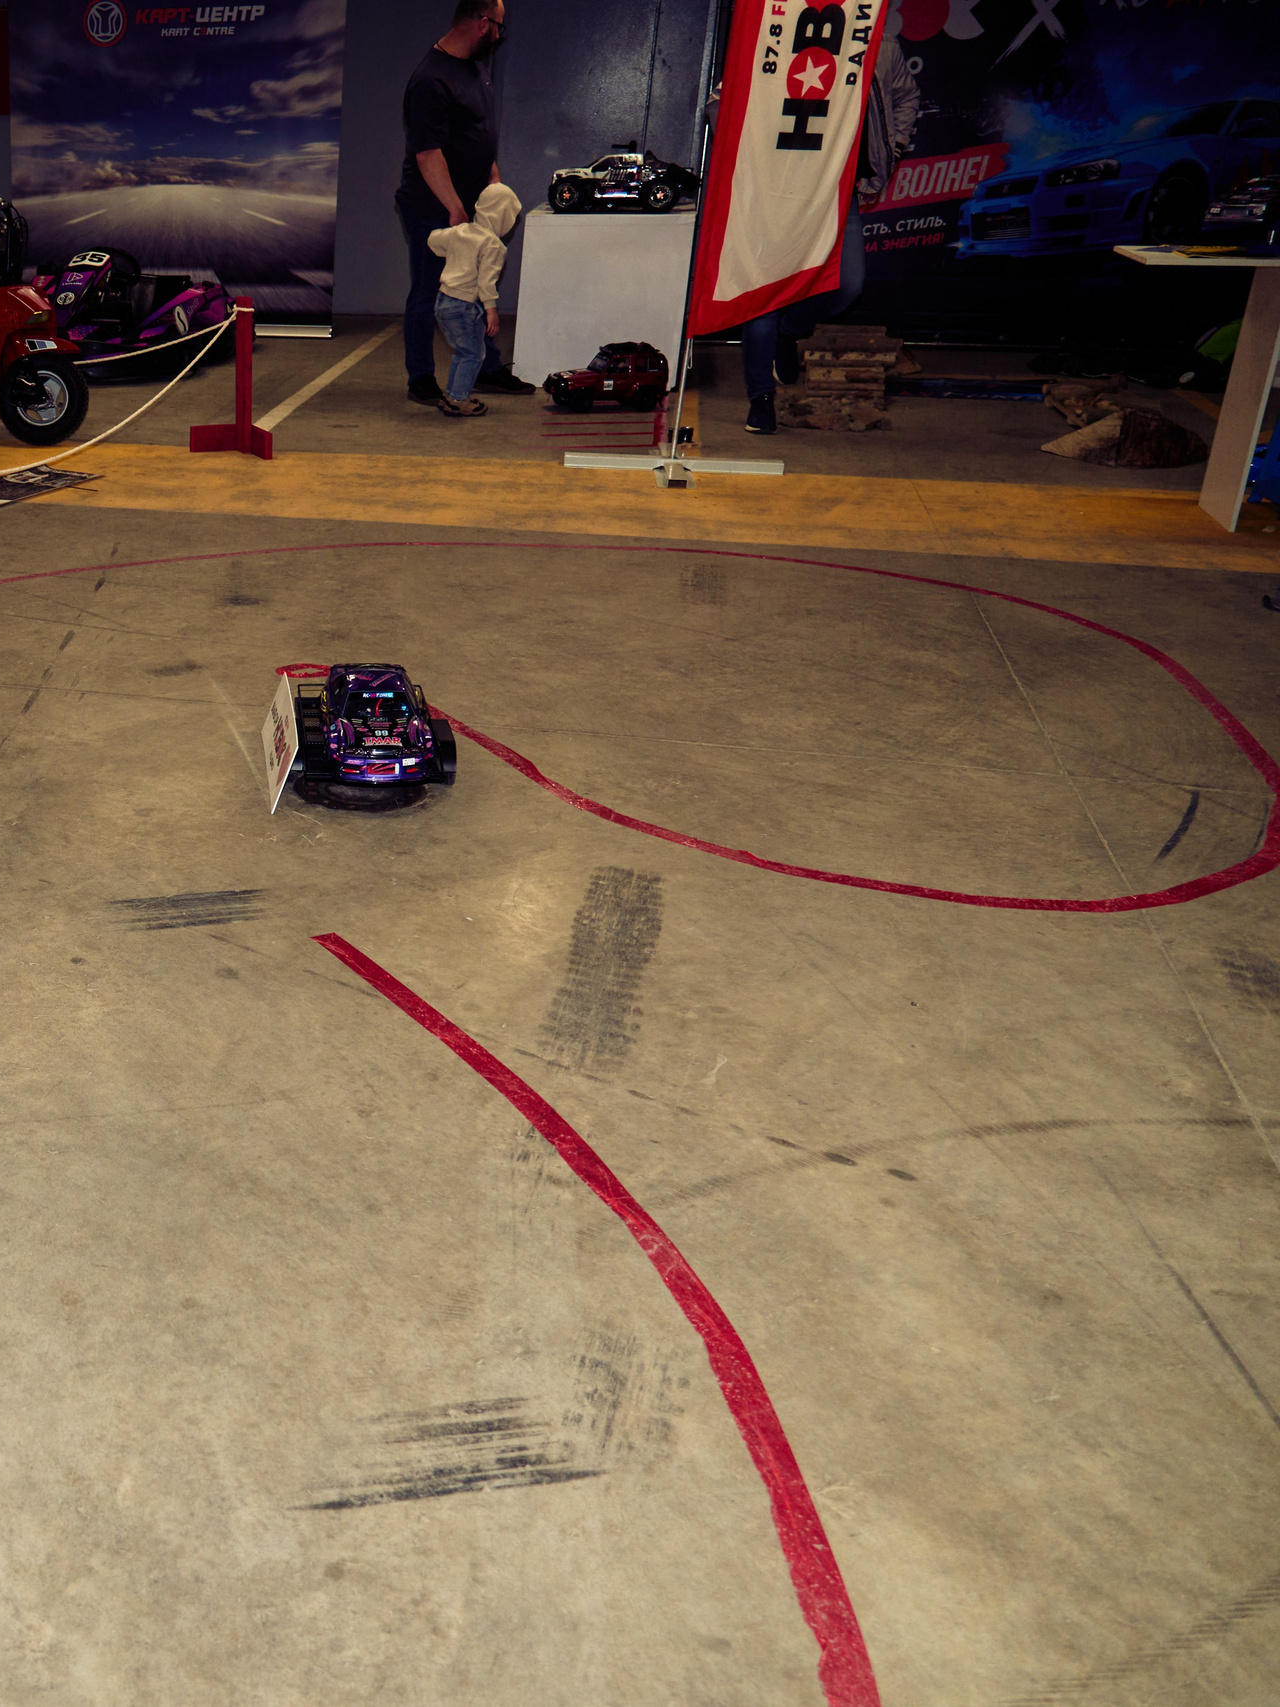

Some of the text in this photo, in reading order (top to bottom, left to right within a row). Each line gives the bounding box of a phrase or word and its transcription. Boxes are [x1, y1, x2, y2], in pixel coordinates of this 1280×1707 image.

[161, 28, 190, 37] KART
[762, 0, 788, 75] 87.8 F
[891, 154, 991, 201] ВОЛНЕ!
[895, 216, 947, 233] СТИЛЬ.
[880, 232, 946, 251] ЭНЕРГИЯ!
[72, 253, 107, 264] 35
[374, 729, 389, 737] 99
